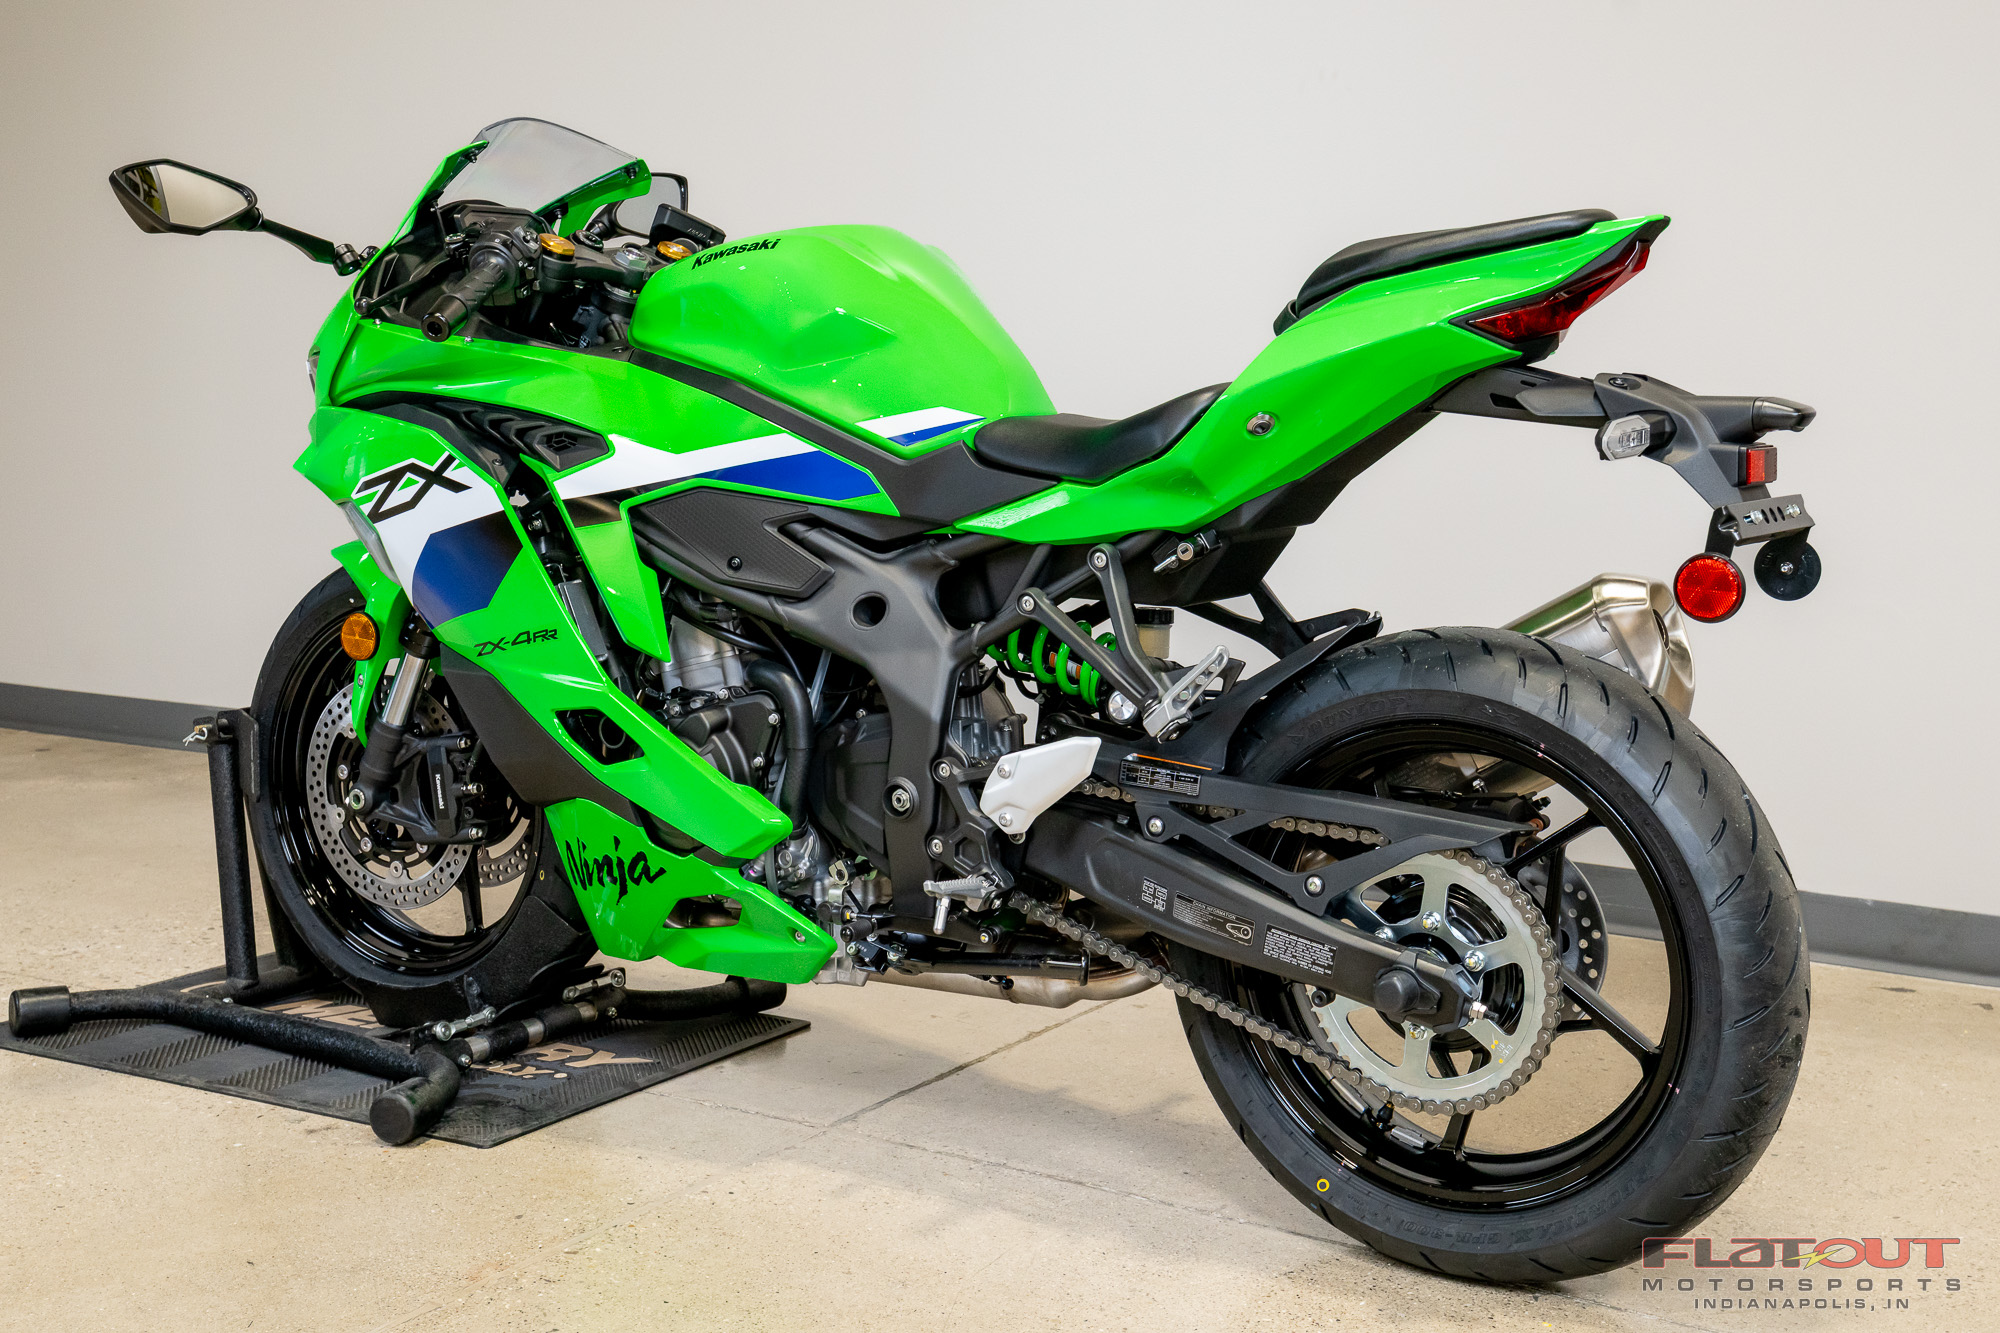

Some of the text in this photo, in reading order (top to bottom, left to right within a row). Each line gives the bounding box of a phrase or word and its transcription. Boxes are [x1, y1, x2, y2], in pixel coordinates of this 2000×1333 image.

[691, 238, 781, 270] Kawasaki
[355, 452, 473, 525] ZX
[474, 629, 558, 657] ZX-4RR
[435, 773, 445, 809] Kawasaki
[565, 835, 667, 906] Ninja
[1206, 906, 1236, 920] INFORMATION
